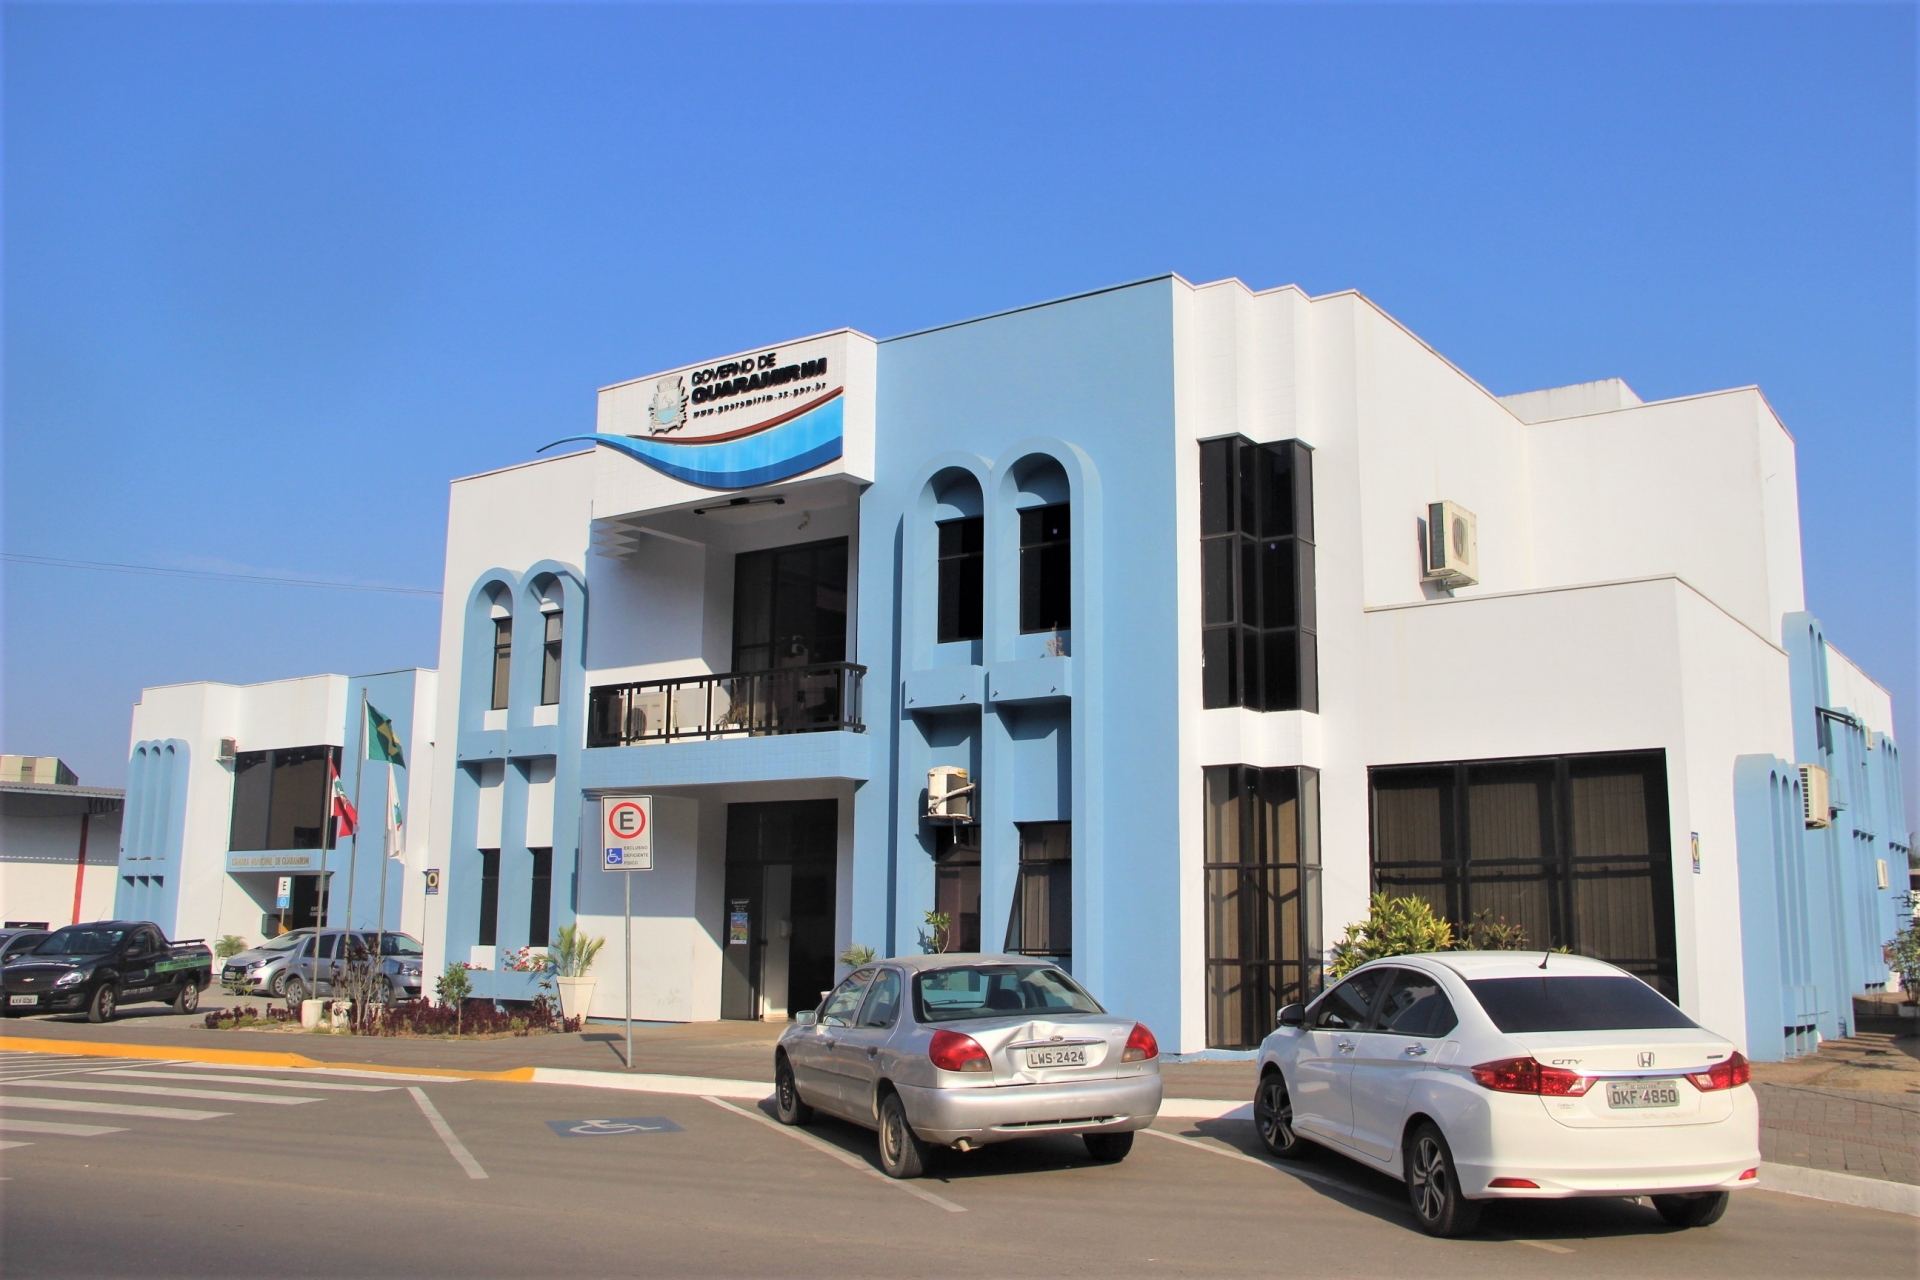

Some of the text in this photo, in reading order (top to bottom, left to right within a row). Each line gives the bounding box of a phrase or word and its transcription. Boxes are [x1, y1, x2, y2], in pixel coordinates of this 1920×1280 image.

[691, 352, 777, 386] GOVERNO DE
[691, 357, 827, 405] GUARAMIRIM
[619, 811, 634, 830] E
